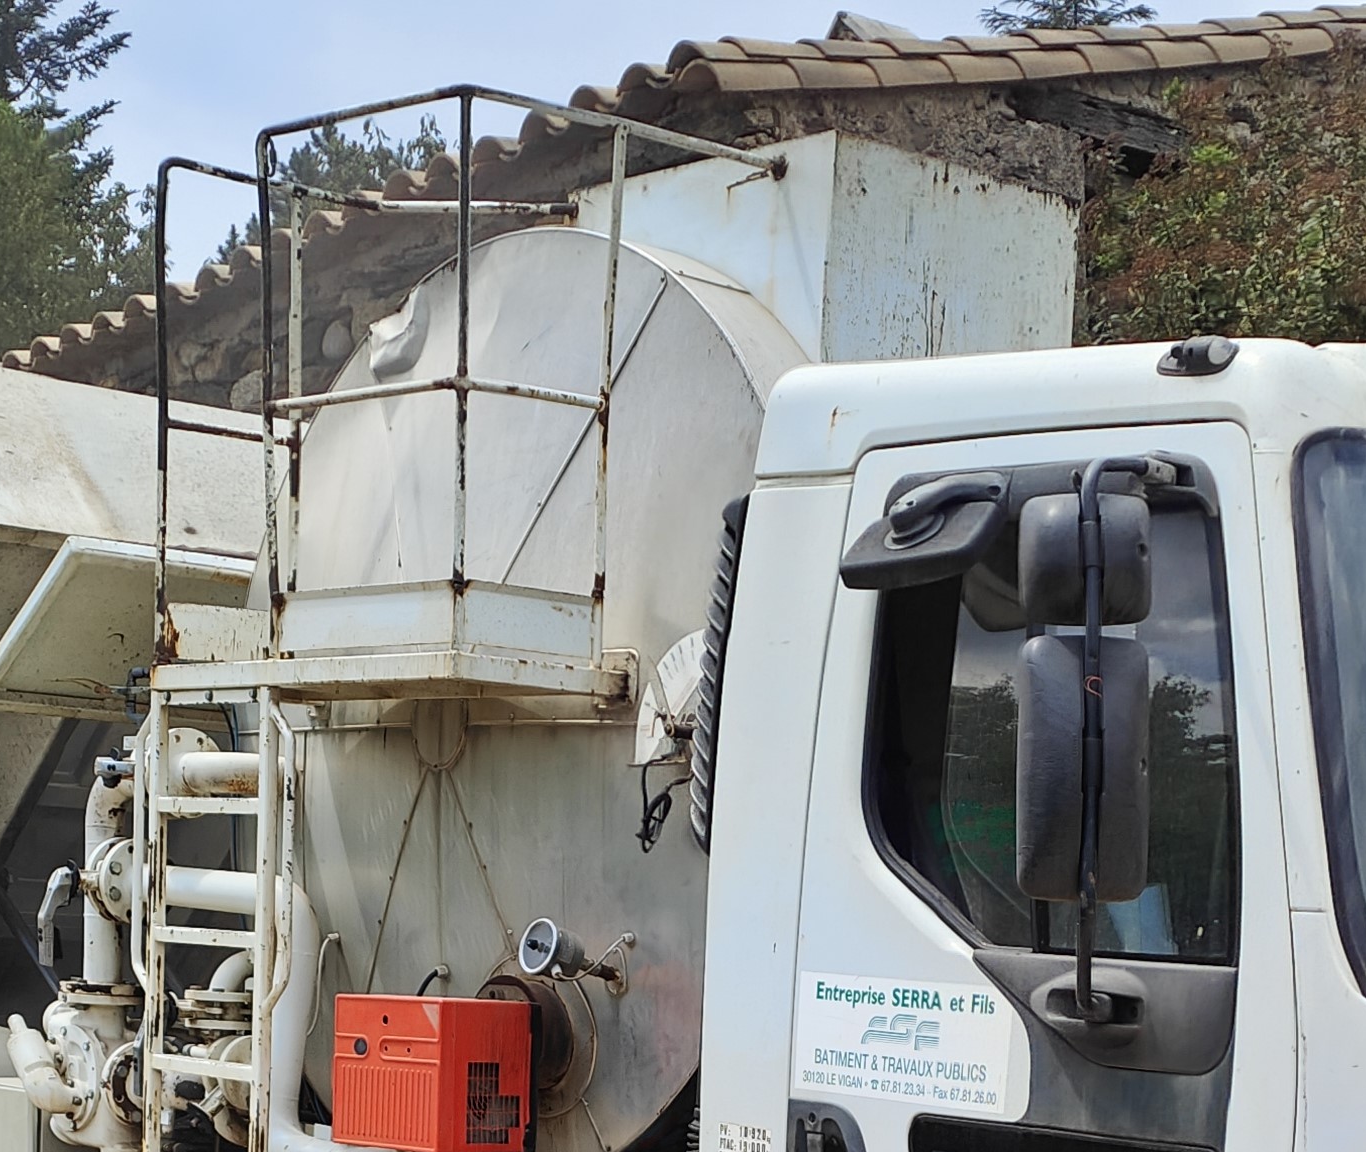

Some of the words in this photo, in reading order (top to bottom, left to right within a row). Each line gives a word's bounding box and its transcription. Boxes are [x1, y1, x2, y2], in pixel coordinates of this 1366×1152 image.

[816, 981, 885, 1008] Entreprise
[892, 987, 942, 1010] SERRA
[950, 994, 965, 1012] et
[971, 993, 995, 1014] Fils
[814, 1048, 869, 1070] BATIMENT
[871, 1055, 878, 1071] &
[882, 1056, 933, 1078] TRAVAUX
[935, 1062, 986, 1083] PUBLICS
[802, 1070, 825, 1084] 30120
[826, 1072, 836, 1085] LE
[838, 1073, 863, 1089] VIGAN
[933, 1086, 948, 1100] Fax
